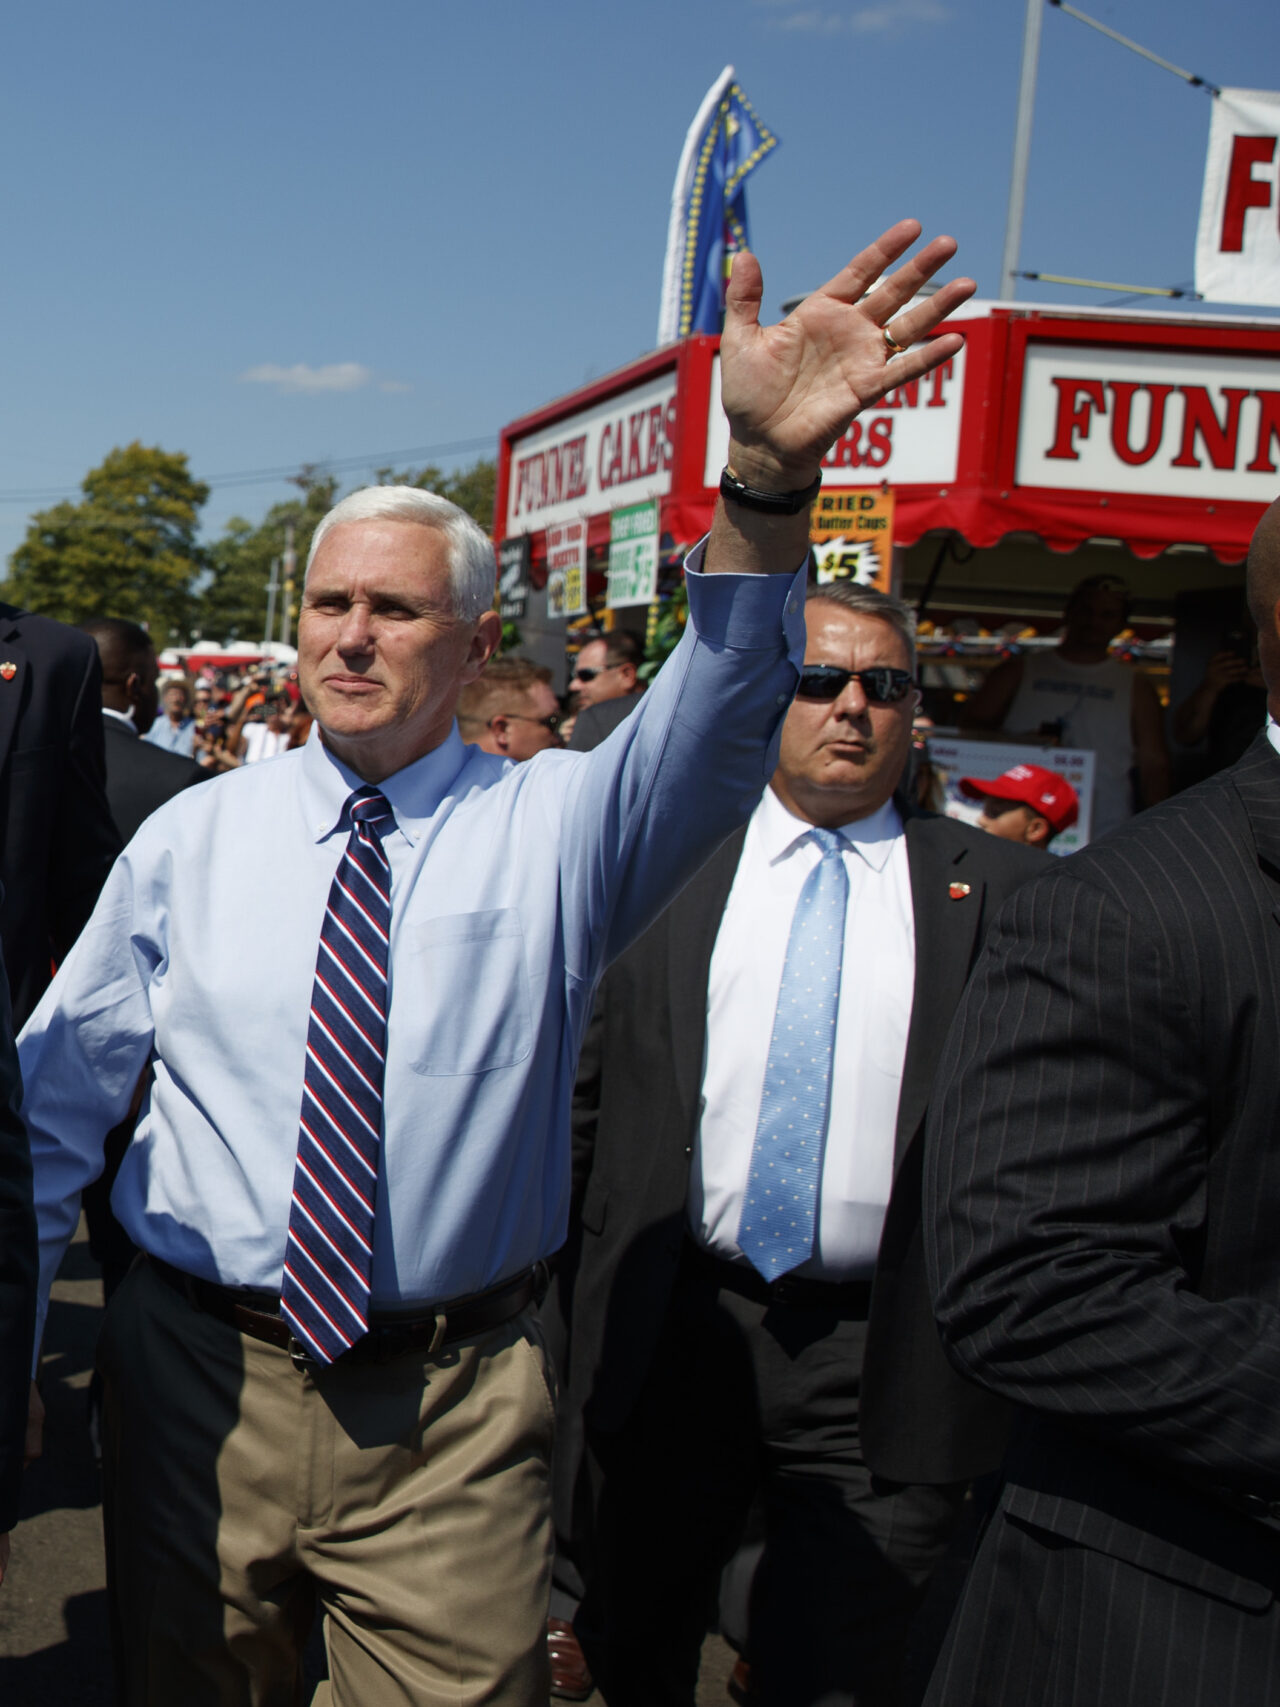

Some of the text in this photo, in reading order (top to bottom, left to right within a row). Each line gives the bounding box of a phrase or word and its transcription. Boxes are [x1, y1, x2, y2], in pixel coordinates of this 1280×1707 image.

[1218, 134, 1280, 253] F
[597, 394, 677, 491] CAKES
[814, 496, 875, 511] RIED
[824, 552, 859, 581] $5
